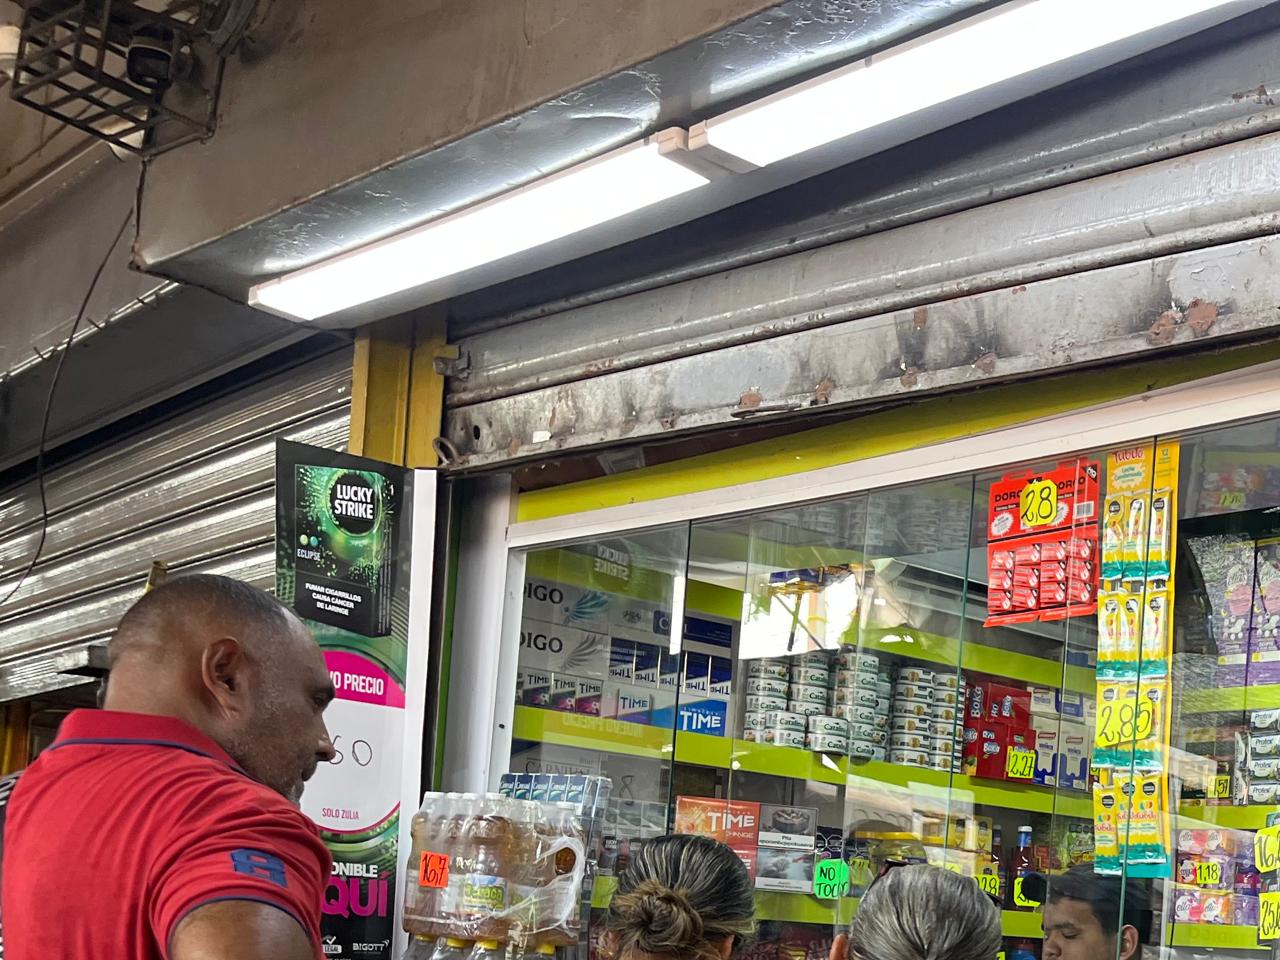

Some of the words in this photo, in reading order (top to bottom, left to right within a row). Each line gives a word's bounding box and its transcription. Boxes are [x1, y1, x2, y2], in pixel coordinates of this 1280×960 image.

[336, 484, 373, 502] LUCKY
[334, 499, 374, 520] STRIKE
[1021, 485, 1053, 523] 2,8
[297, 548, 321, 562] ECLIPSE
[343, 676, 384, 695] PRECIO
[528, 674, 549, 686] TIME
[554, 679, 575, 689] TIME
[579, 683, 600, 694] TIME
[620, 696, 648, 709] TIME
[680, 710, 720, 731] TIME
[1099, 700, 1150, 744] 2,85
[322, 807, 339, 819] SOLO
[340, 807, 359, 821] ZULIA
[707, 811, 755, 833] TIME
[819, 866, 836, 881] NO
